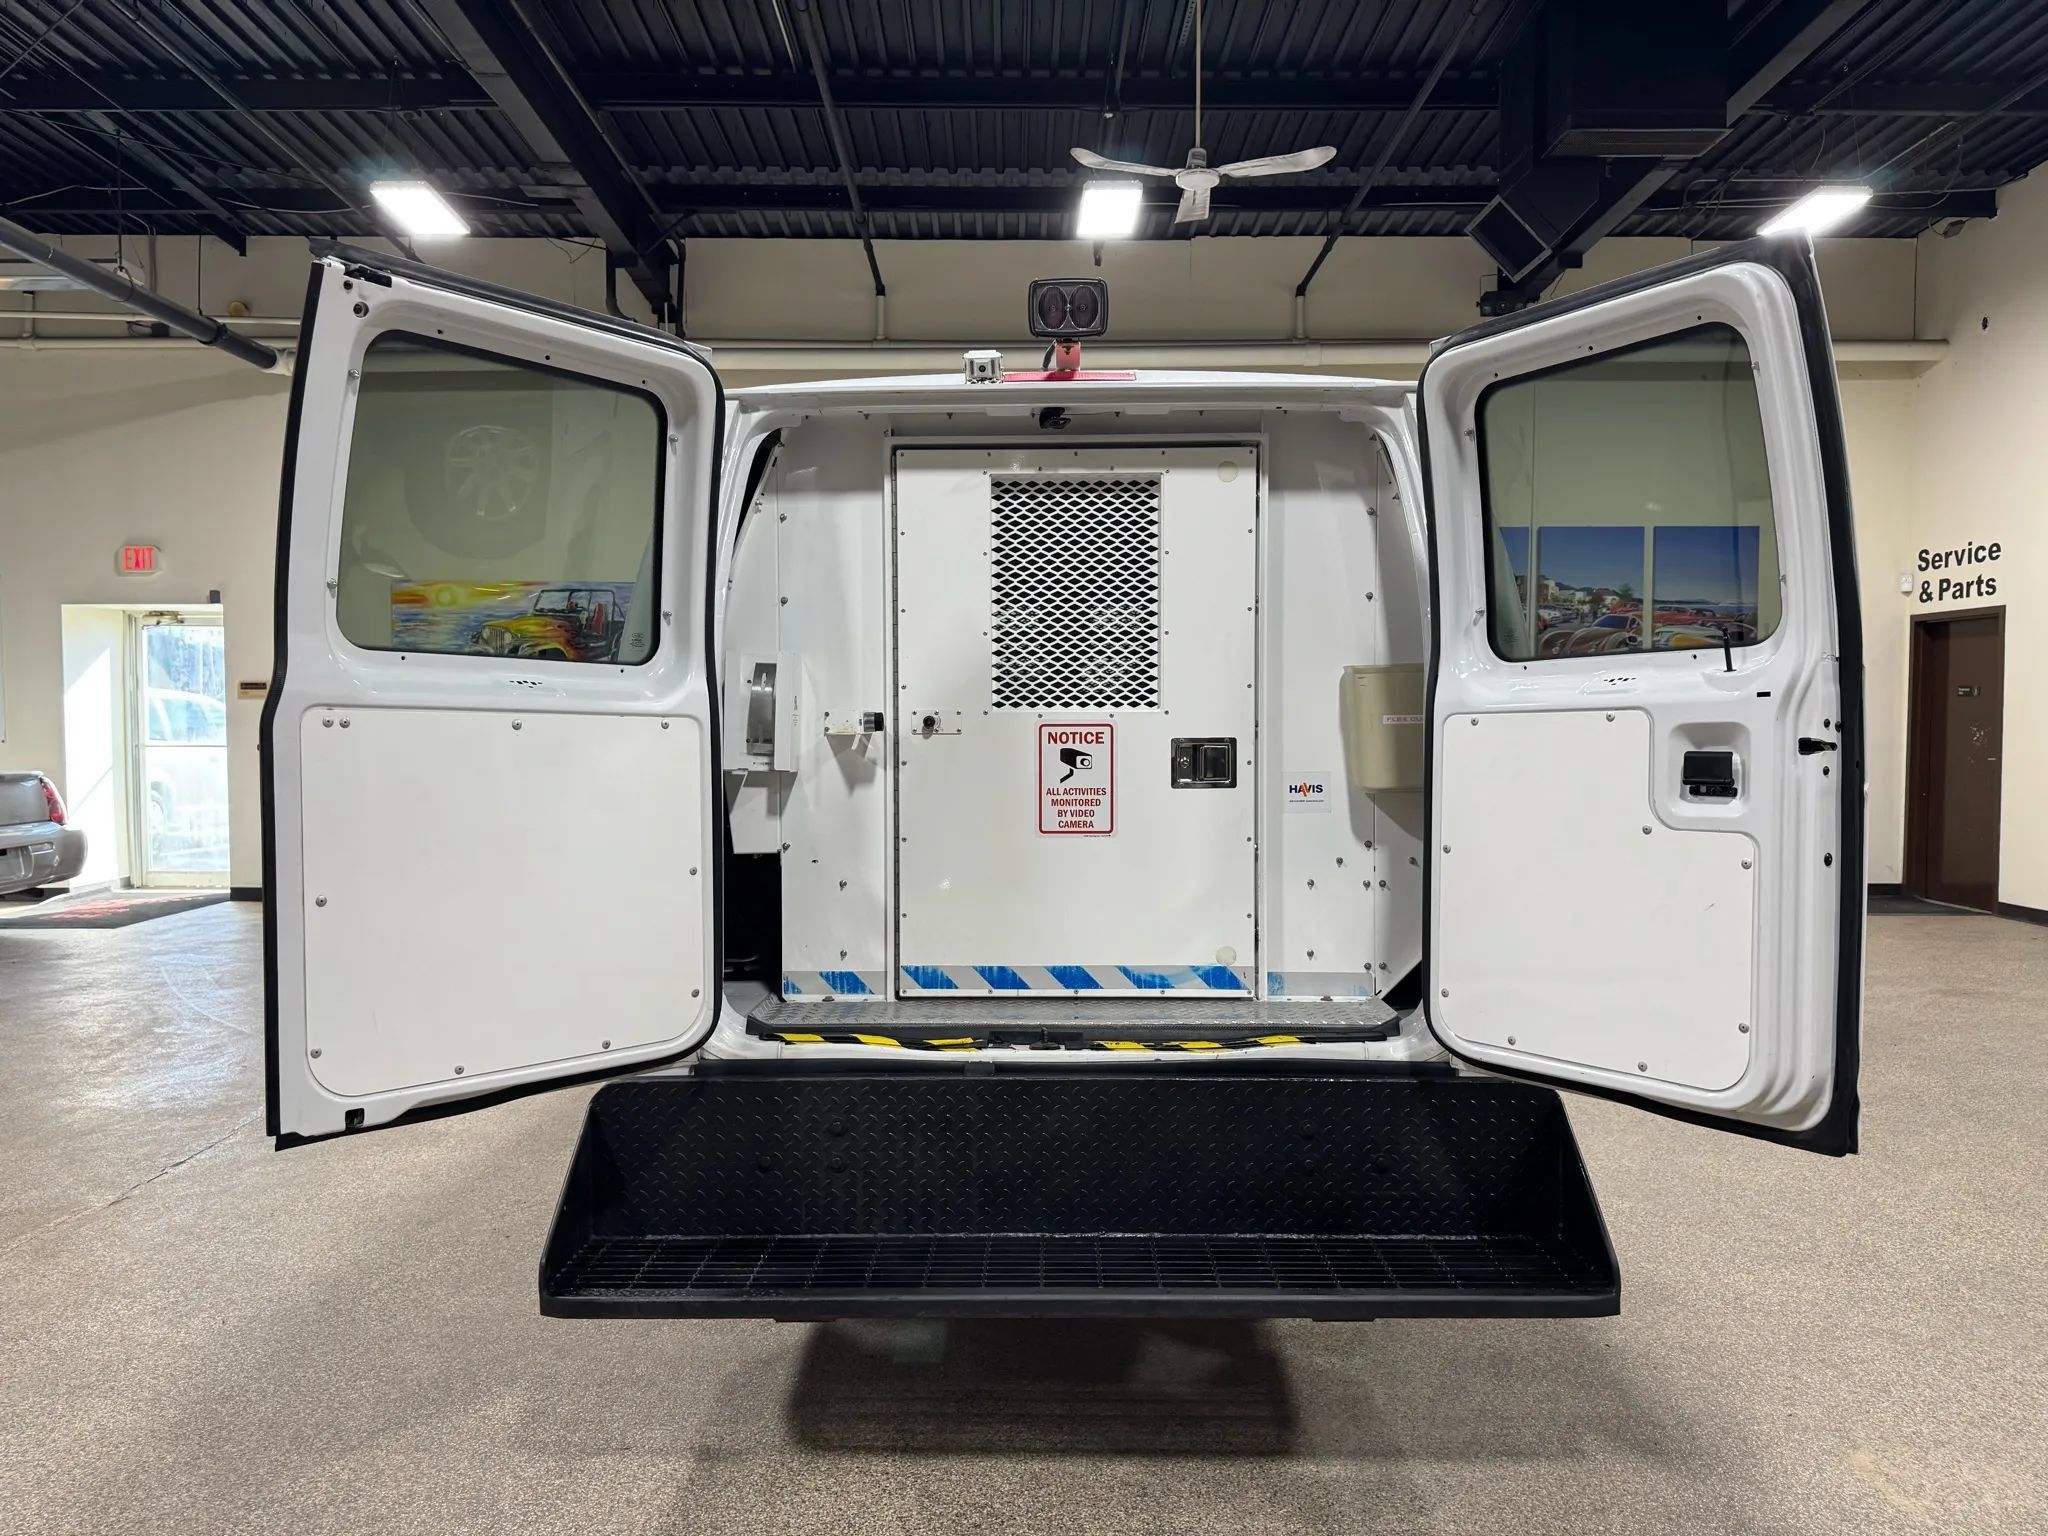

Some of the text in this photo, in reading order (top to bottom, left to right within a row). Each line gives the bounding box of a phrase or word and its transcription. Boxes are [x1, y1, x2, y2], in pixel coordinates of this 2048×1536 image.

[124, 548, 154, 570] EXIT
[1918, 542, 2001, 572] Service
[1919, 574, 1997, 603] & Parts
[1047, 731, 1105, 744] NOTICE
[1046, 787, 1107, 796] ALL ACTIVITIES
[1289, 783, 1323, 795] HAVIS
[1051, 798, 1101, 807] MONITORED
[1057, 809, 1095, 818] BY VIDEO
[1058, 820, 1094, 829] CAMERA
